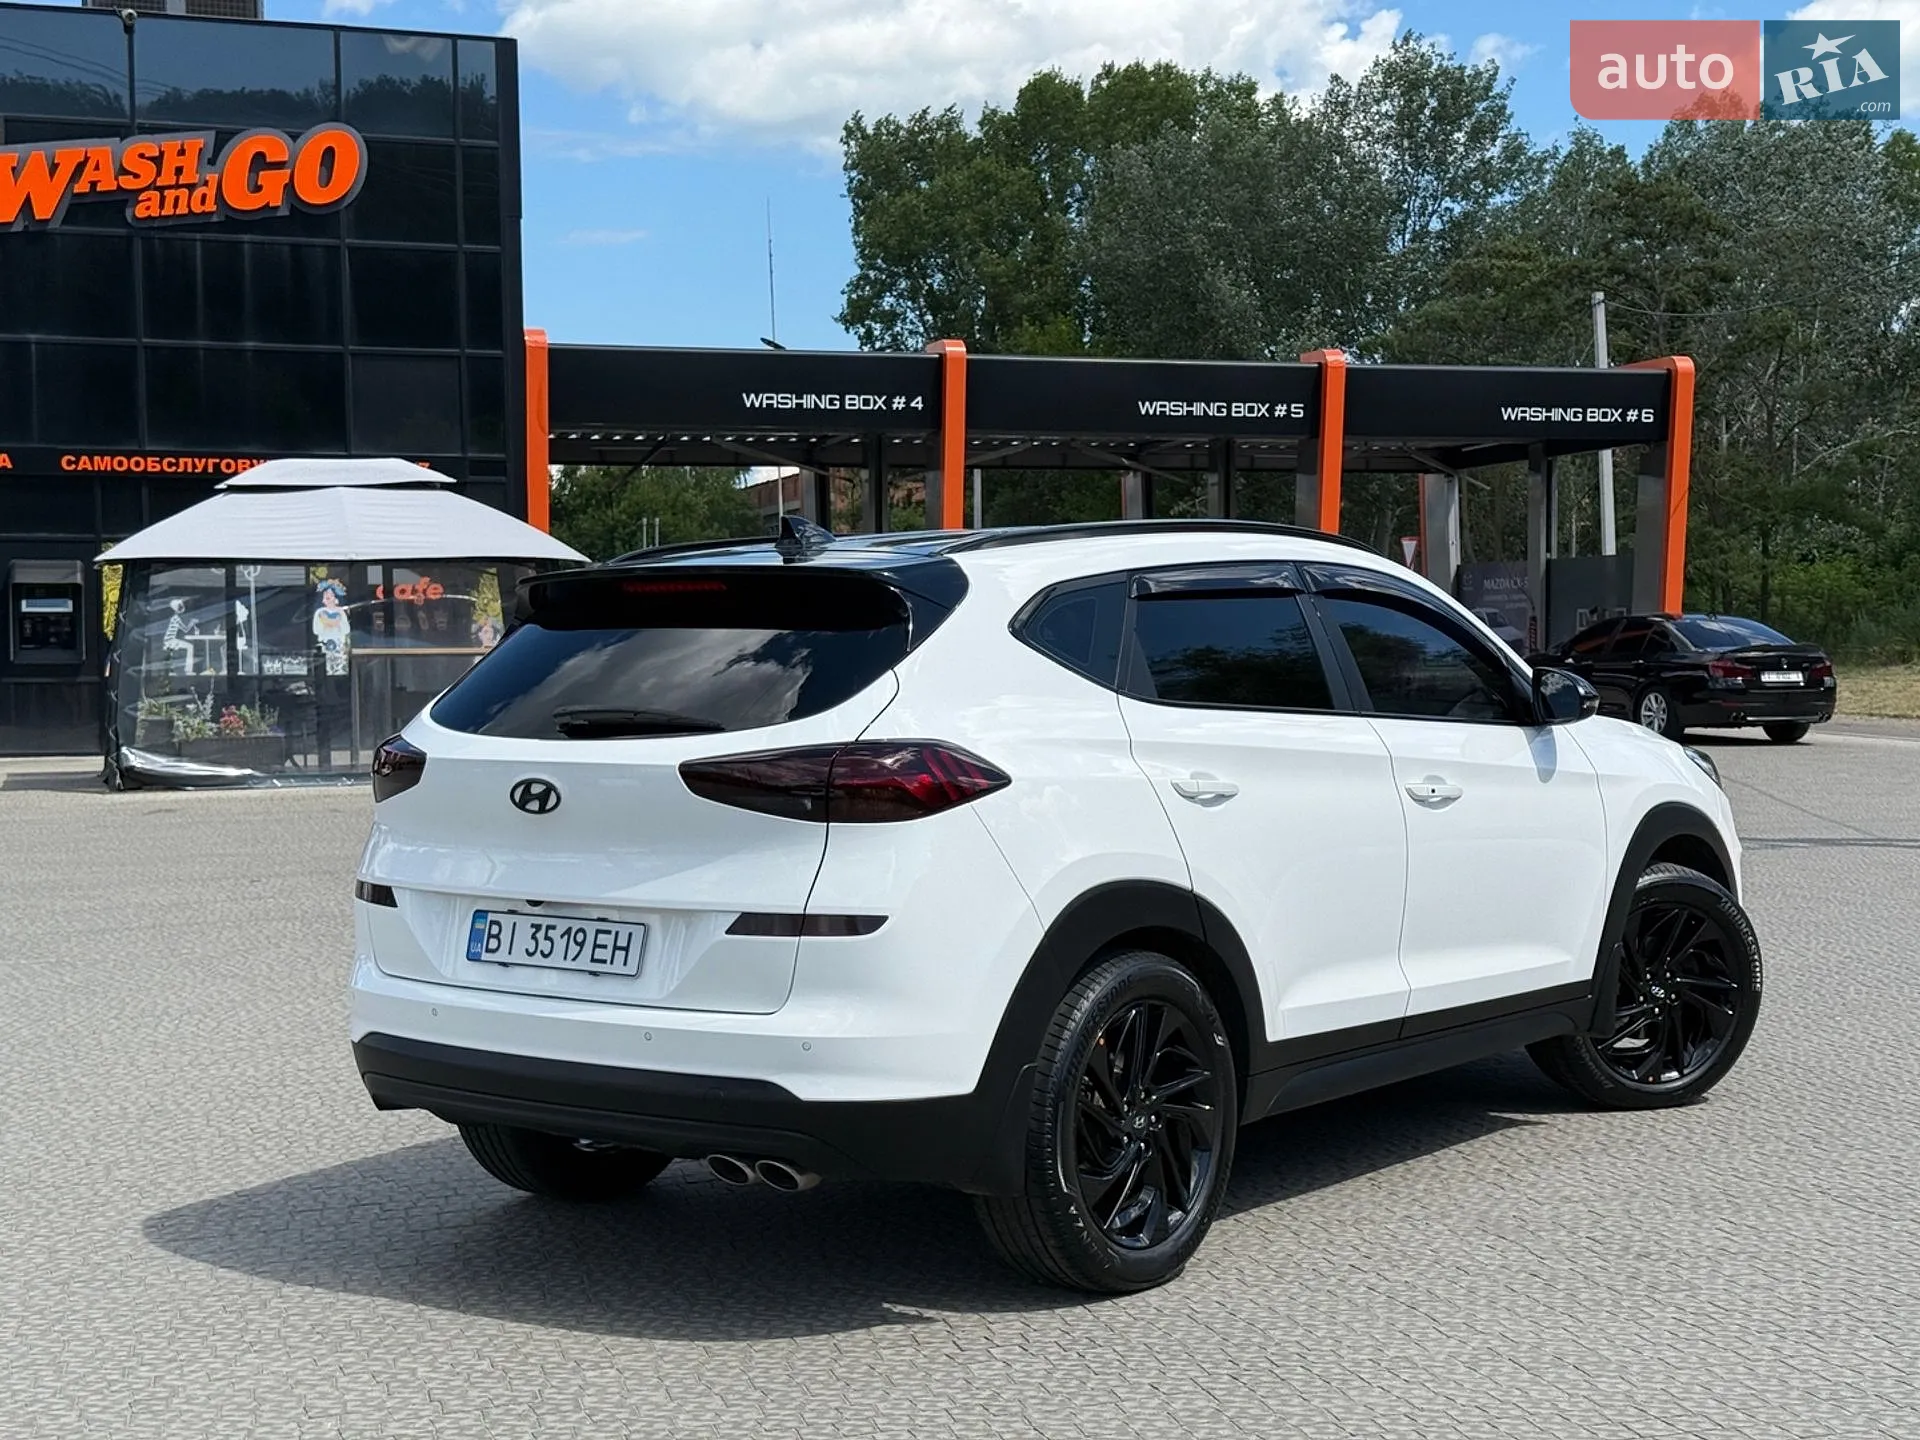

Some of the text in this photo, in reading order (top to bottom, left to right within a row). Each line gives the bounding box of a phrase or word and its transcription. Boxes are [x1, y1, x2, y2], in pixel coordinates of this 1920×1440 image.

[0, 129, 360, 223] WASH and GO
[742, 392, 840, 410] WASHING
[845, 394, 888, 411] BOX
[1138, 400, 1227, 417] WASHING
[1231, 402, 1270, 418] BOX
[1501, 406, 1583, 422] WASHING
[1586, 407, 1623, 422] BOX
[525, 922, 588, 962] 3519
